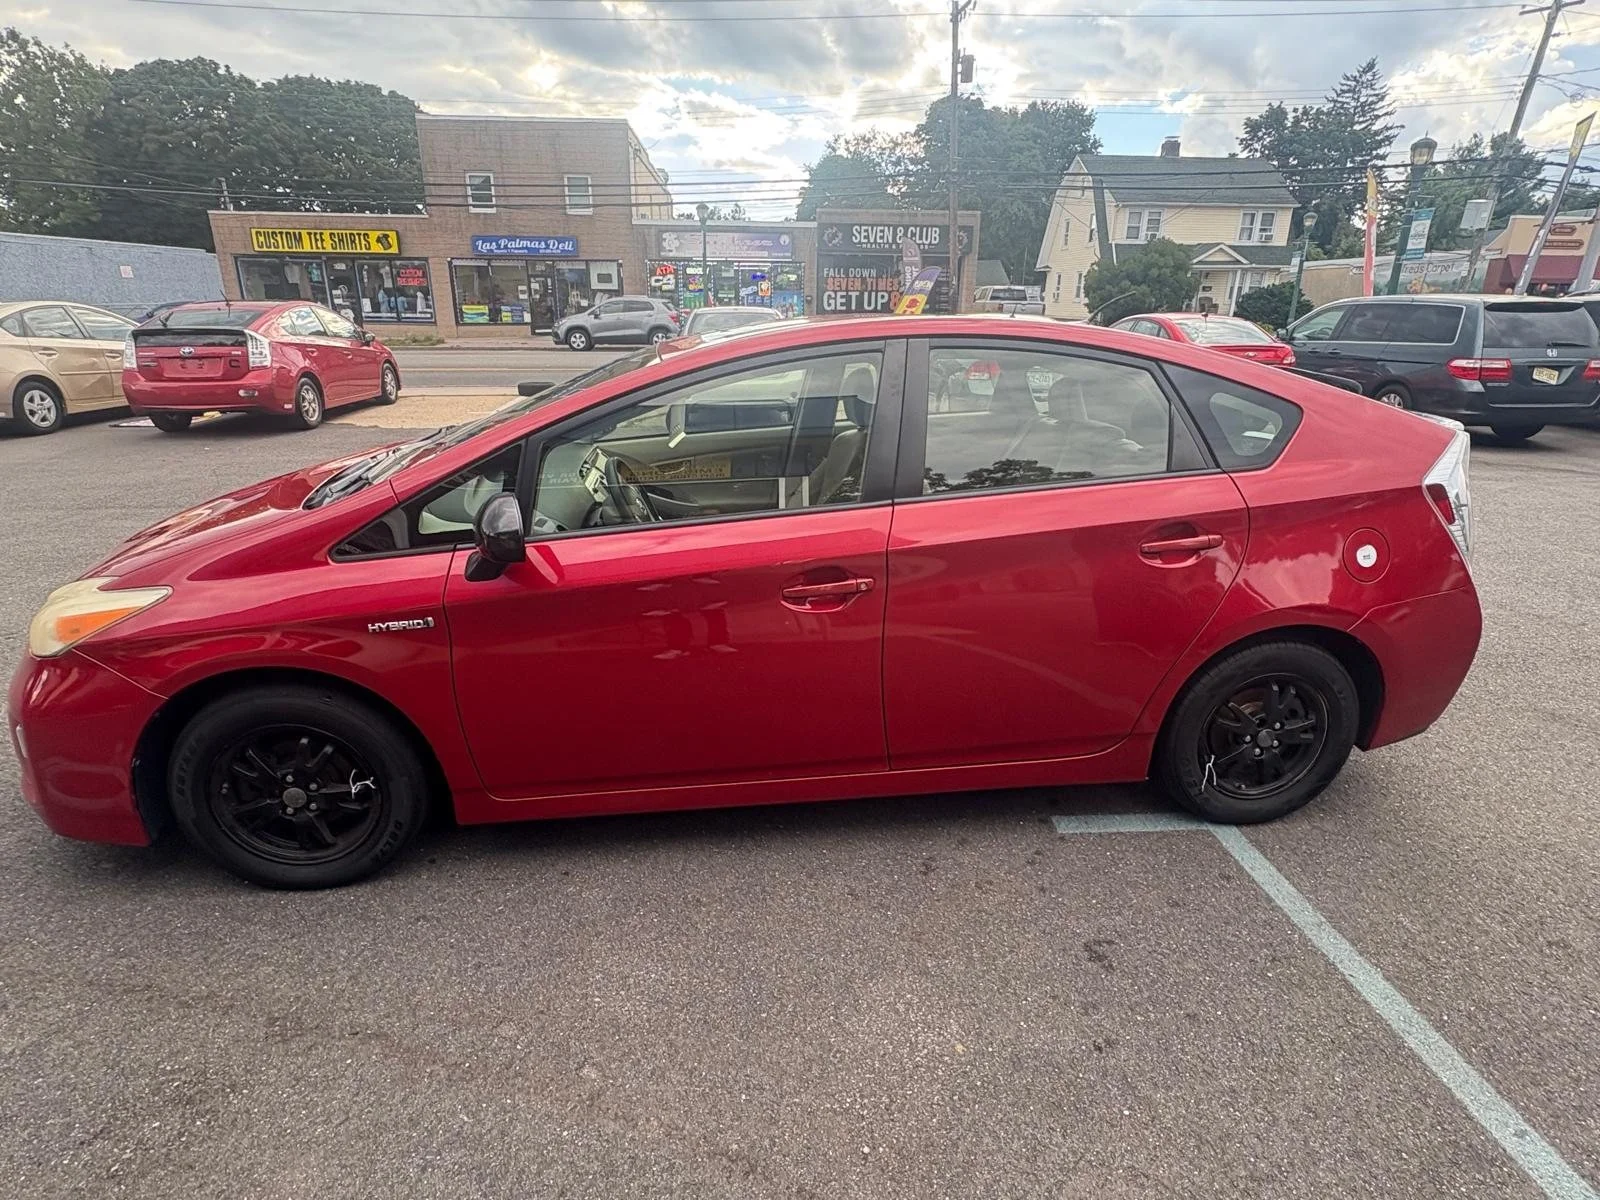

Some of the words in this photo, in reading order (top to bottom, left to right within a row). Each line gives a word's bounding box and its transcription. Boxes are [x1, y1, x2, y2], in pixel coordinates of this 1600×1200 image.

[255, 230, 305, 250] CUSTOM
[305, 231, 327, 250] TEE
[329, 231, 371, 251] SHIRTS
[852, 225, 893, 244] SEVEN
[907, 226, 940, 245] CLUB
[475, 239, 497, 253] Las
[498, 238, 546, 249] Palmas
[547, 239, 574, 251] Deli
[823, 267, 845, 278] FALL
[848, 268, 877, 278] DOWN
[826, 277, 862, 291] SEVEN
[822, 291, 860, 311] GET
[863, 291, 889, 311] UP
[367, 619, 424, 633] HYBRID
